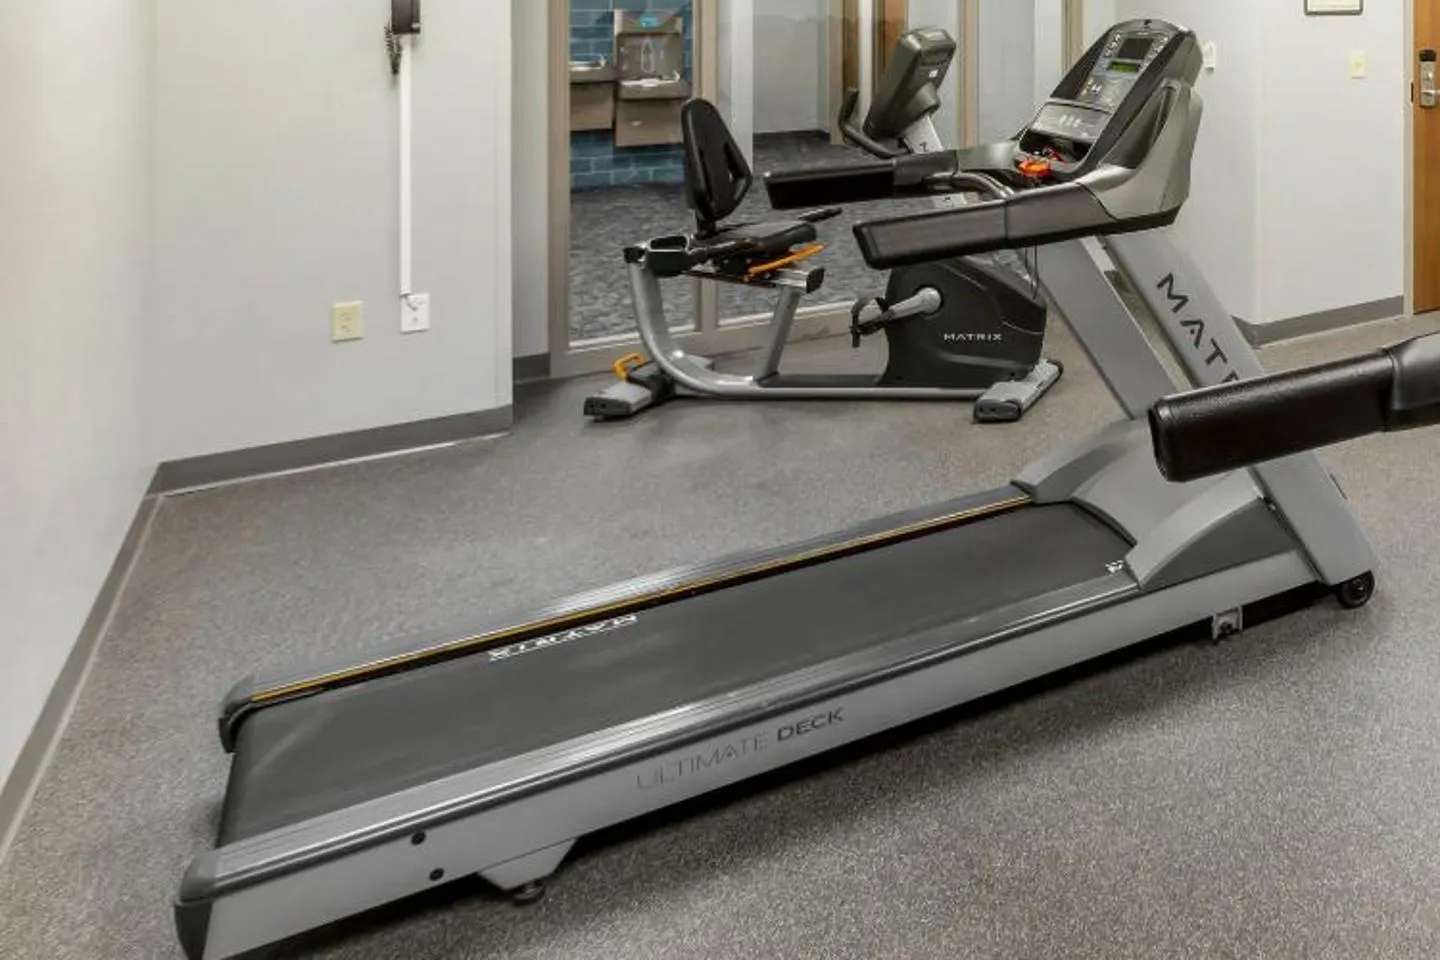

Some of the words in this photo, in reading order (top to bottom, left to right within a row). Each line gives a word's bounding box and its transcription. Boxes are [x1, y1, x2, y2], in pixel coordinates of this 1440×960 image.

[943, 333, 1002, 341] MATRIX
[636, 733, 770, 789] ULTIMATE
[777, 707, 845, 742] DECK
